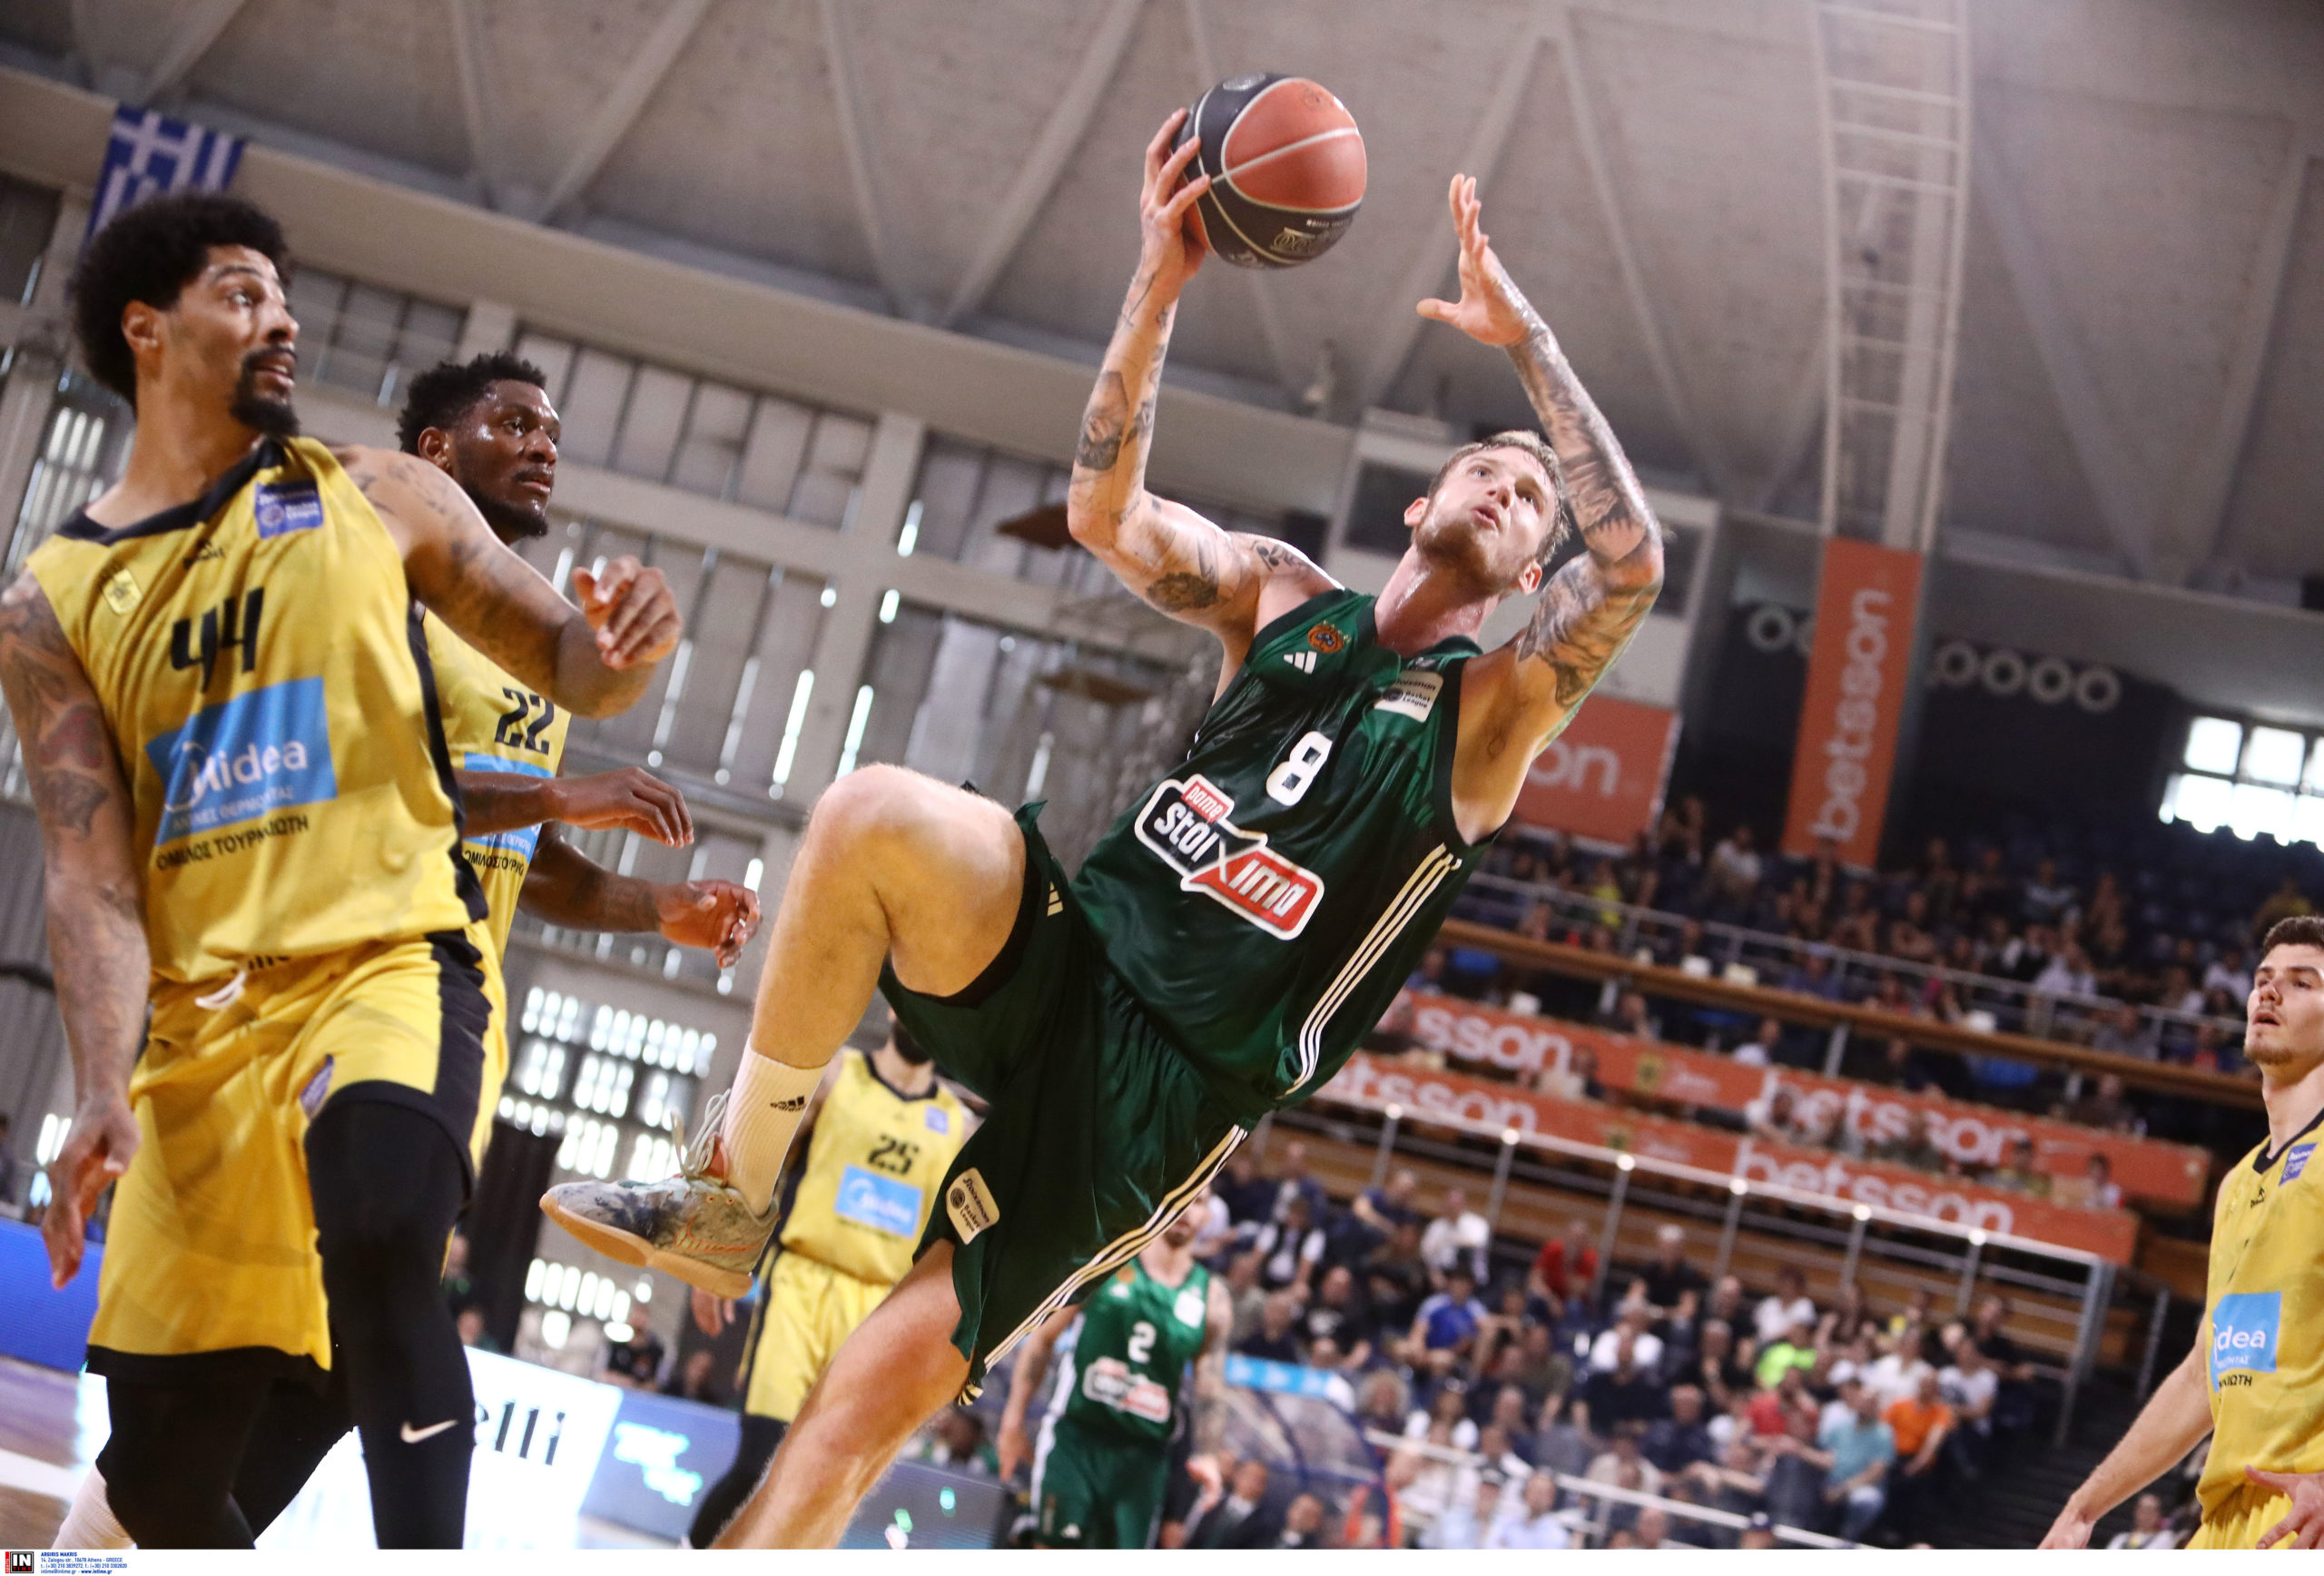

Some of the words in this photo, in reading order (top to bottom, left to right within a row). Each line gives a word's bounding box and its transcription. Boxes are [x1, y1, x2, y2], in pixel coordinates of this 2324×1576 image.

[171, 586, 264, 694] 44
[495, 687, 555, 755] 22
[1808, 587, 1892, 842] betsson
[1185, 785, 1225, 817] pame
[1266, 731, 1333, 806] 8
[1416, 1005, 1571, 1075] sson
[868, 1134, 920, 1176] 25
[1733, 1138, 2015, 1235] betsson
[1128, 1320, 1157, 1364] 2
